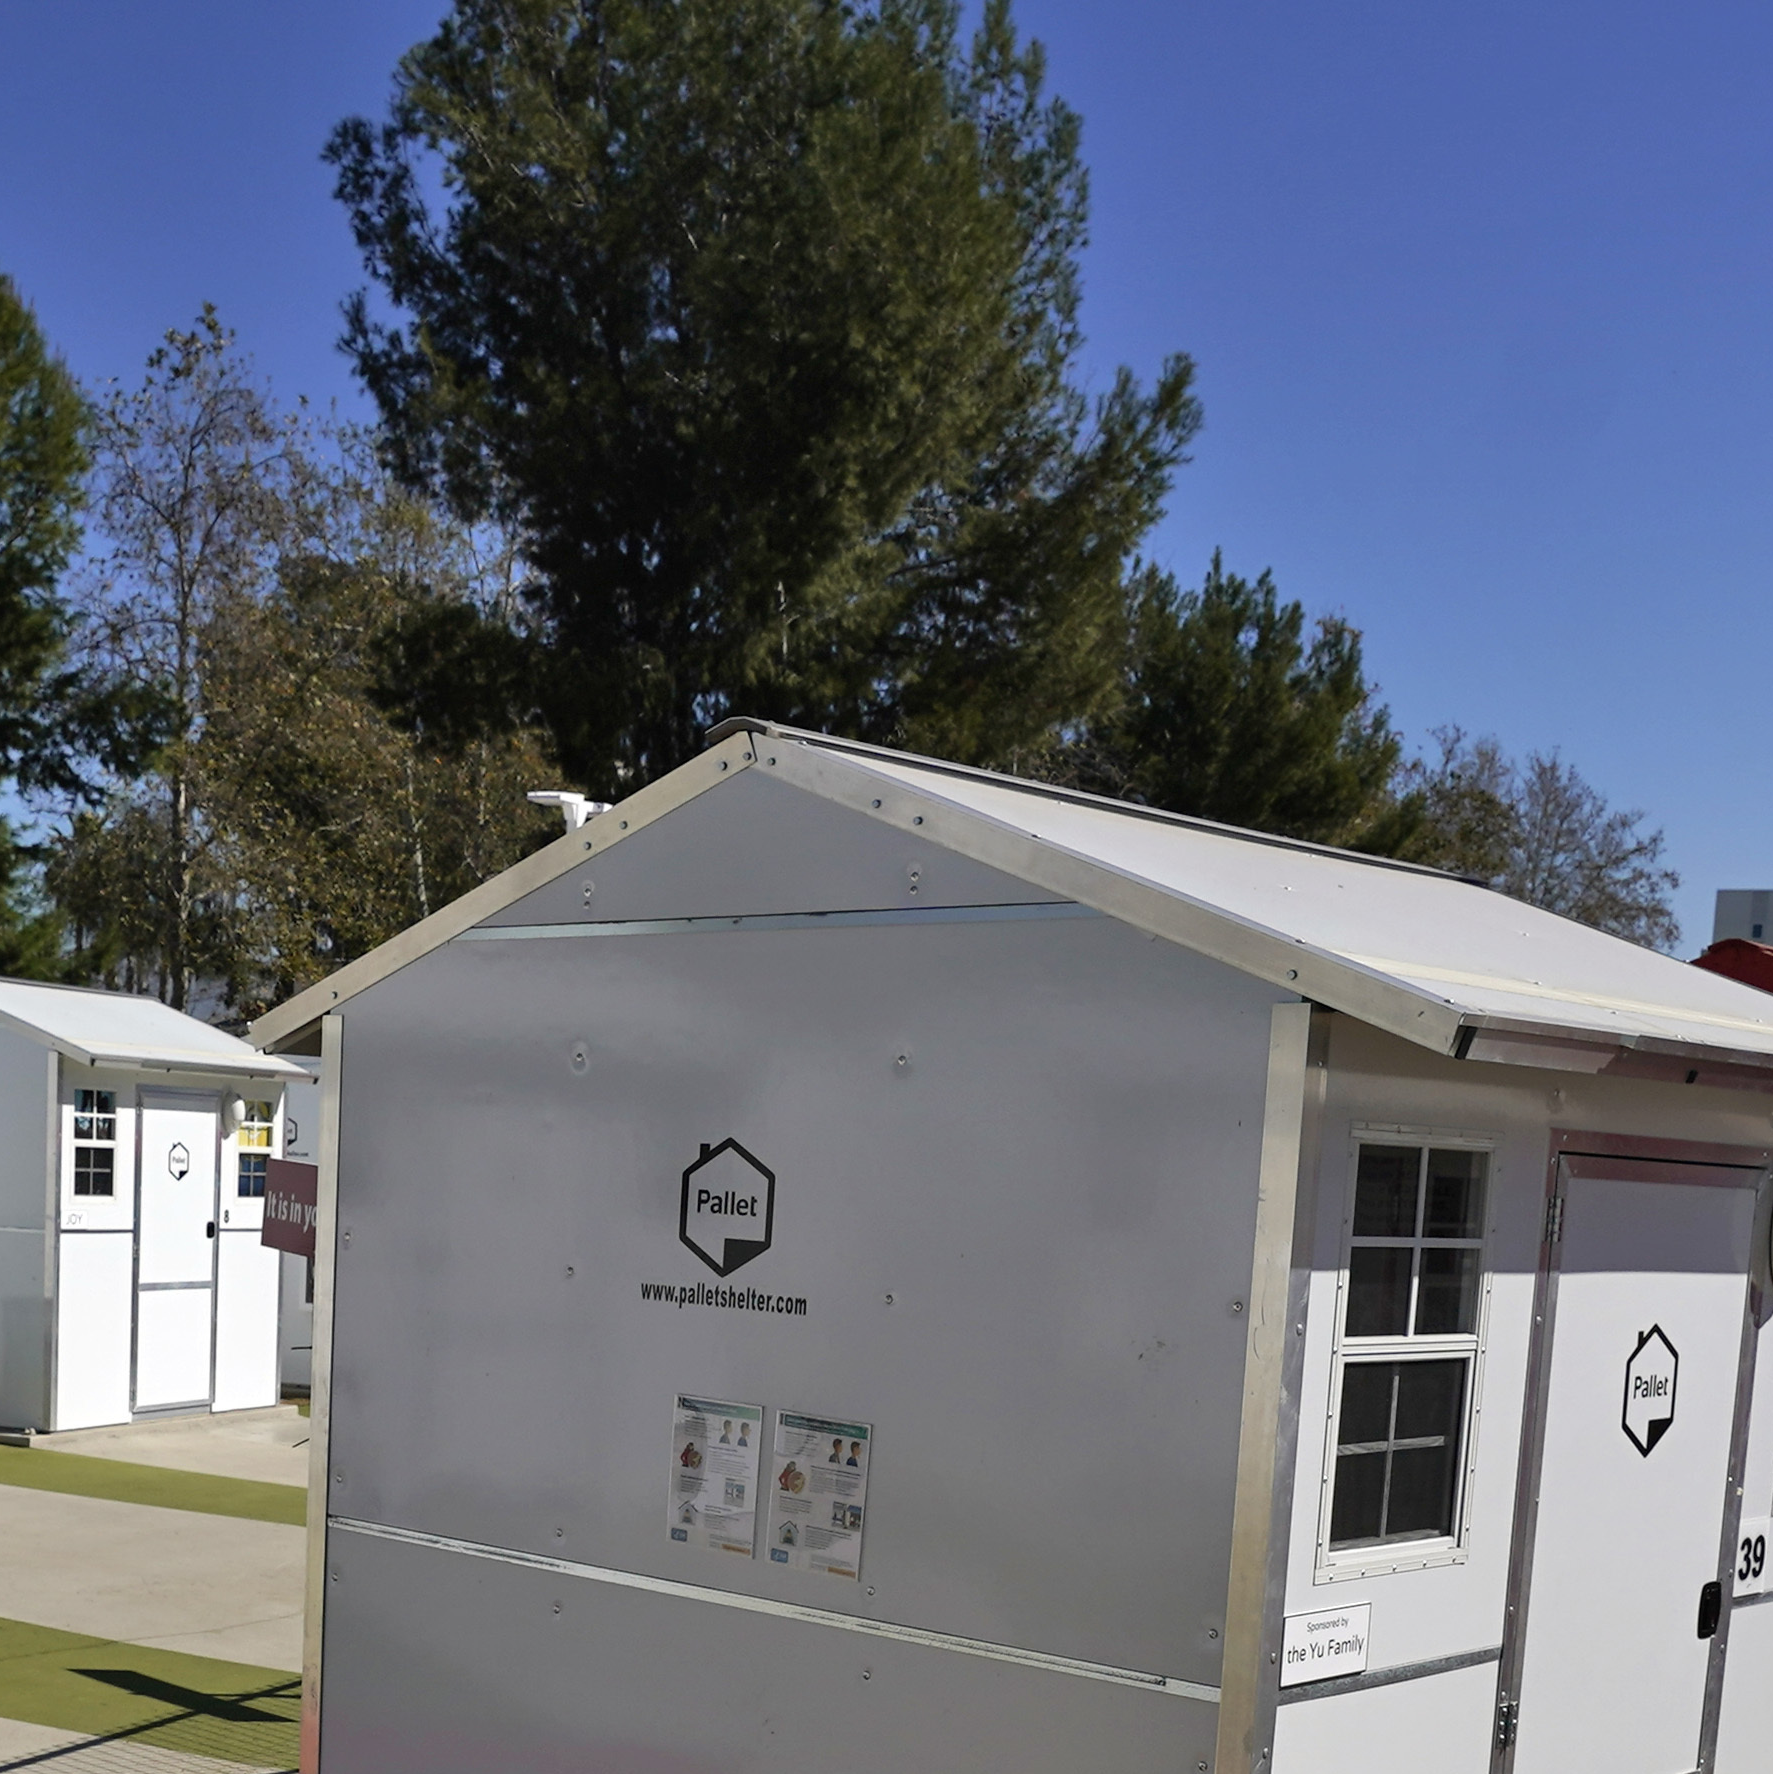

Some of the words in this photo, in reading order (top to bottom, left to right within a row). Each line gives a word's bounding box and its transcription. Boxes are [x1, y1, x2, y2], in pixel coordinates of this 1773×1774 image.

[267, 1190, 276, 1218] It
[277, 1192, 288, 1221] is
[289, 1193, 301, 1224] in
[697, 1189, 758, 1217] Pallet
[641, 1282, 807, 1315] www.palletshelter.com
[1633, 1375, 1669, 1400] Pallet
[1738, 1534, 1766, 1581] 39
[1307, 1618, 1340, 1633] Sponsored
[1341, 1616, 1349, 1629] by
[1287, 1646, 1306, 1664] the
[1309, 1642, 1324, 1659] Yu
[1328, 1635, 1365, 1656] Family
